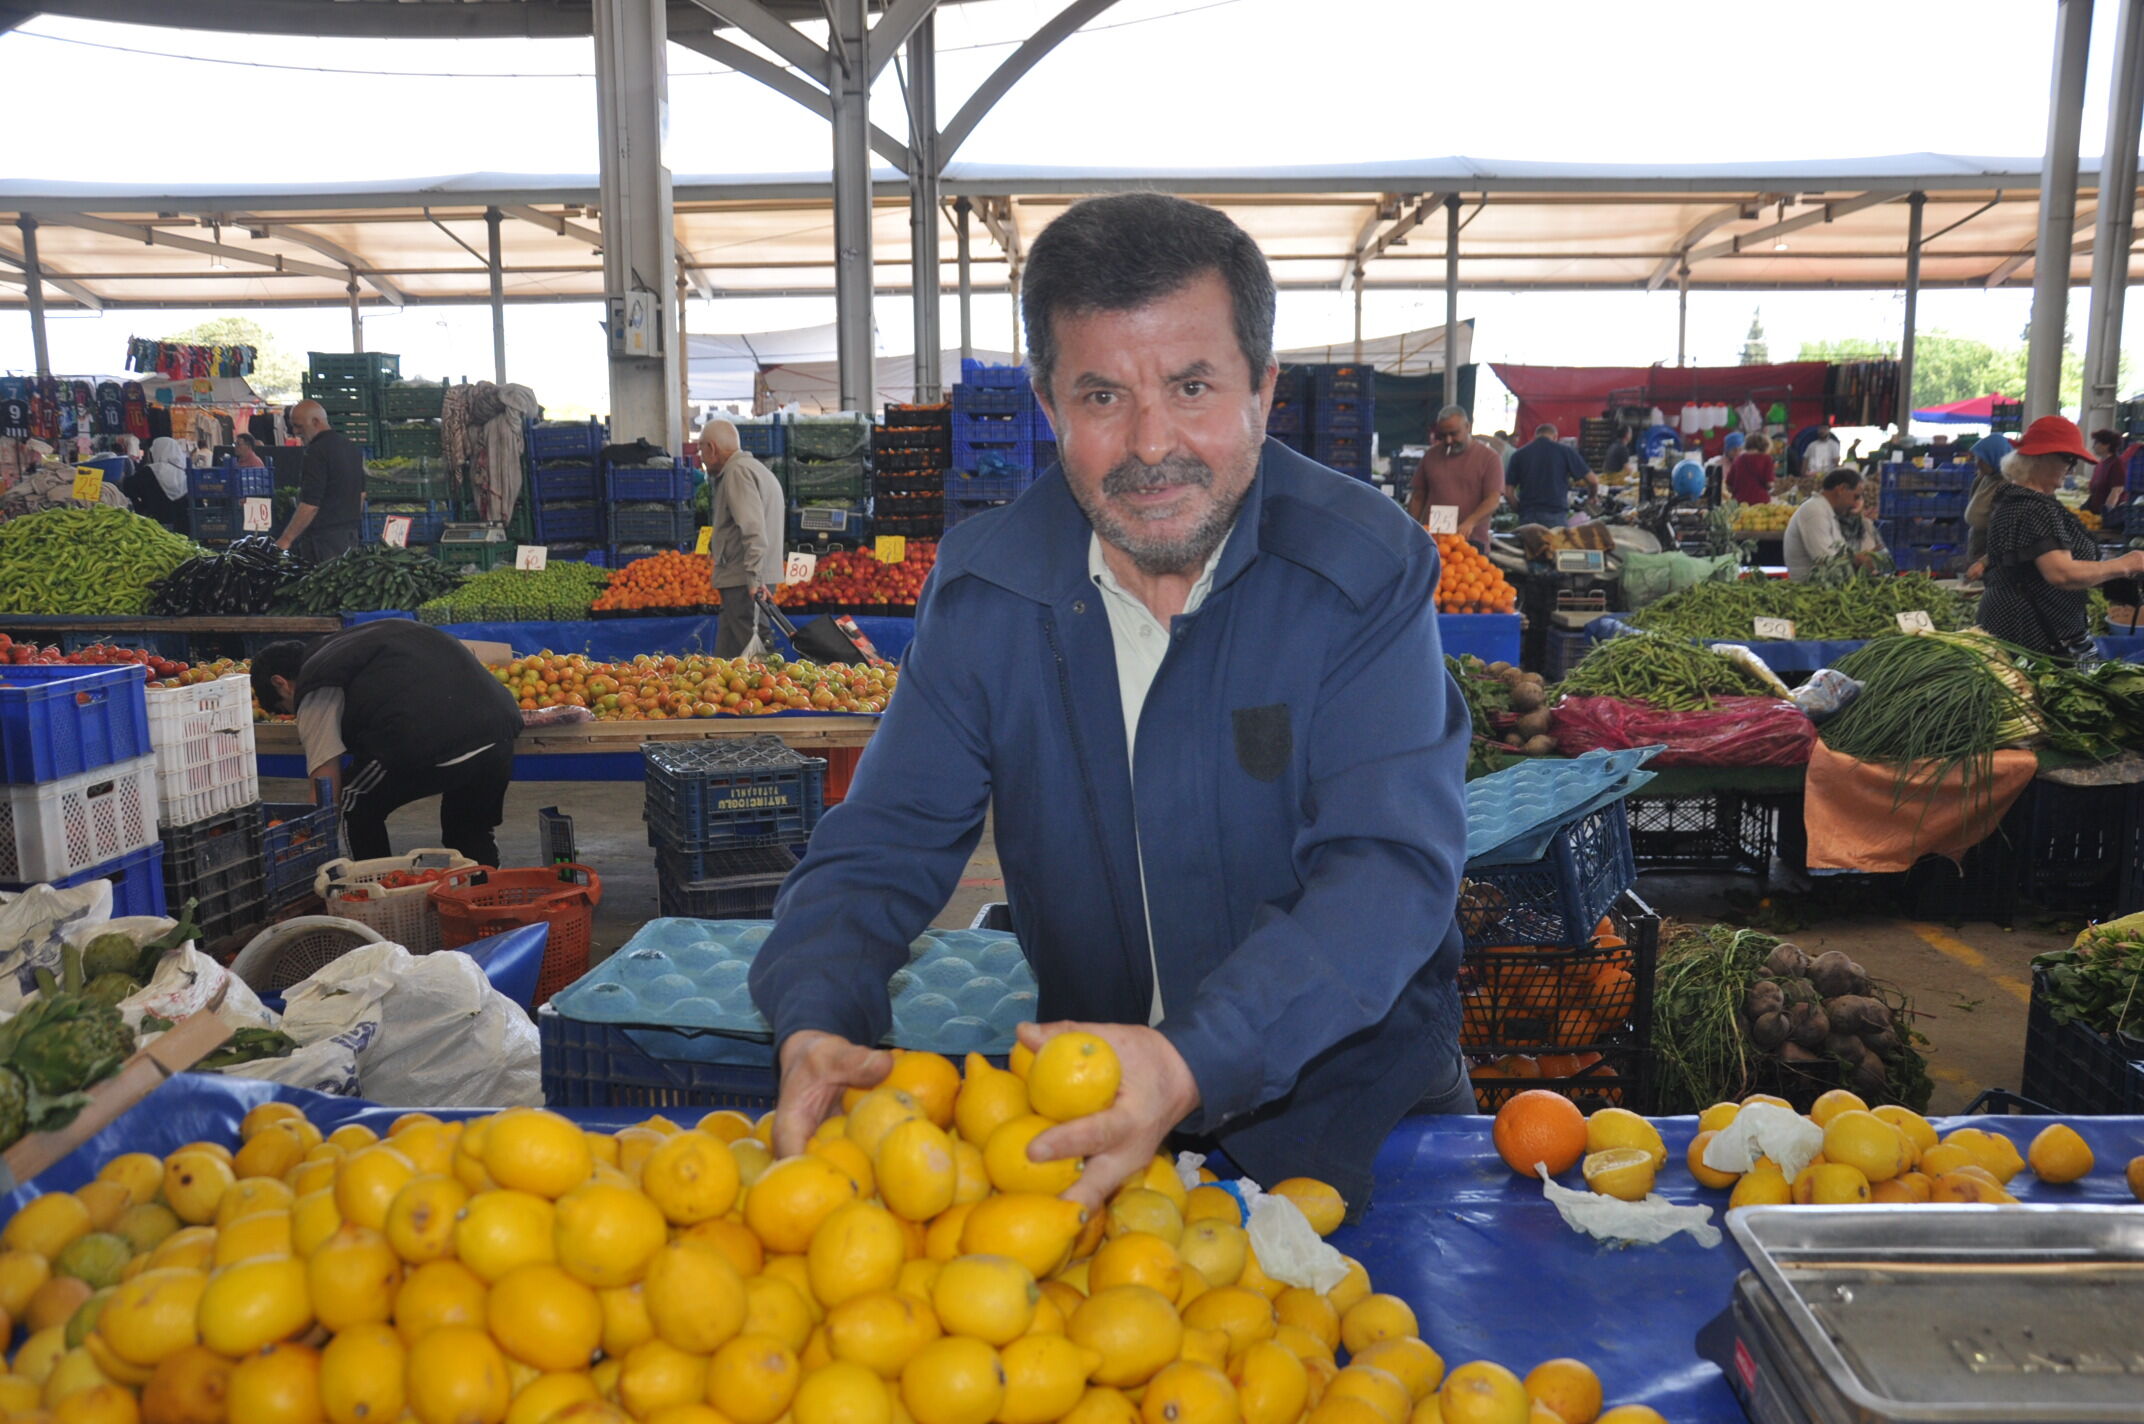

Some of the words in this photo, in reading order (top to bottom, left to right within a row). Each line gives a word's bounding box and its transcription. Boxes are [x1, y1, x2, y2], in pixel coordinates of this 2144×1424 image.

[9, 404, 21, 420] 9
[104, 409, 120, 426] 10
[76, 476, 99, 497] 25
[1431, 510, 1454, 530] 25
[790, 562, 808, 578] 80
[1762, 621, 1786, 634] 50
[1903, 611, 1928, 628] 50
